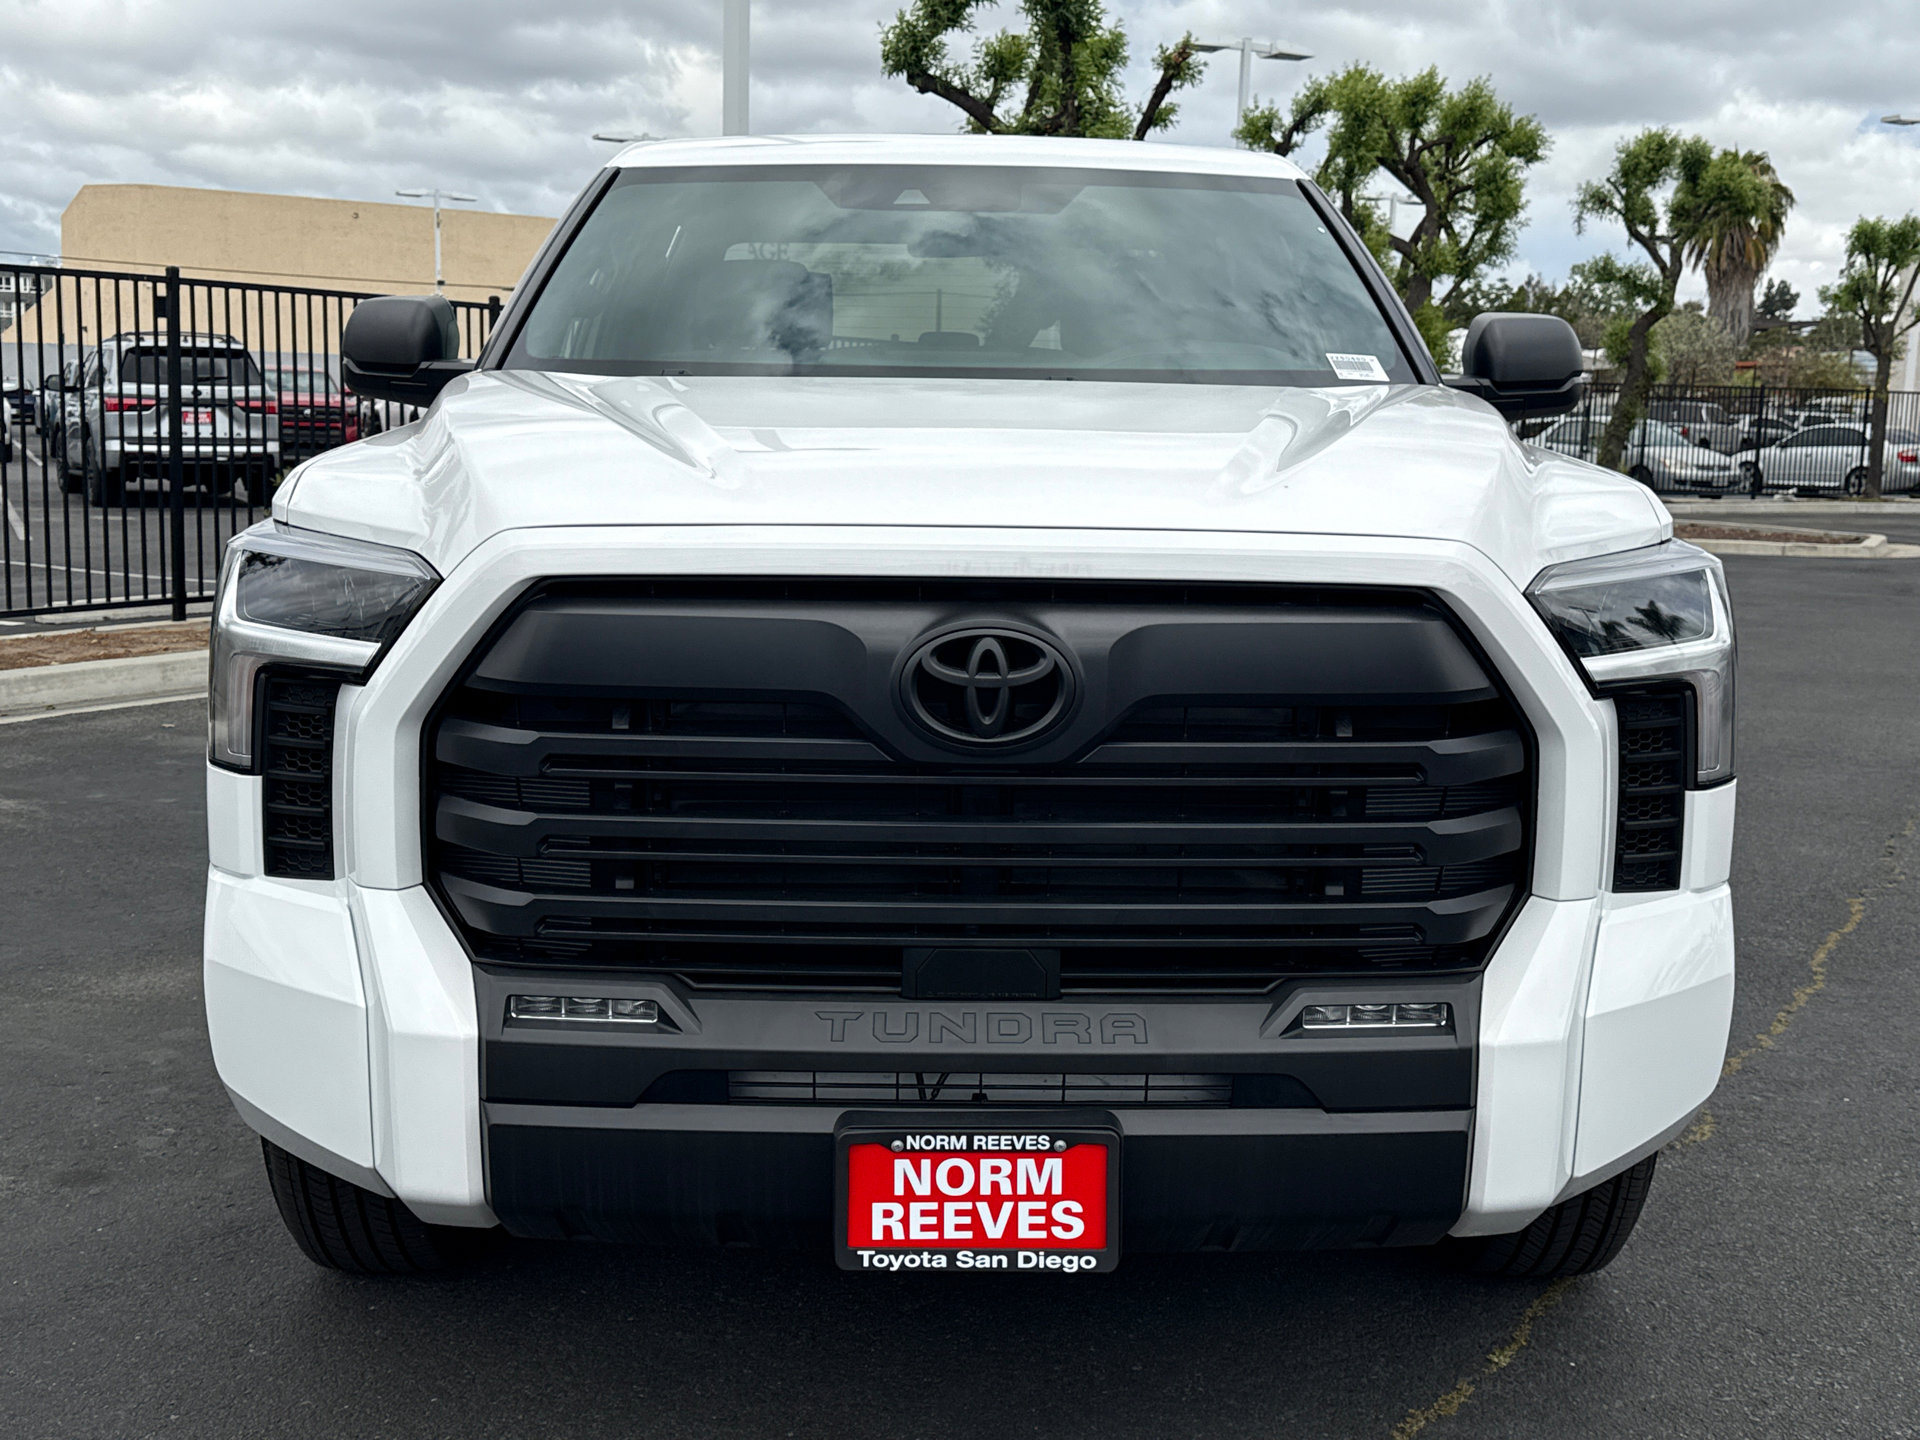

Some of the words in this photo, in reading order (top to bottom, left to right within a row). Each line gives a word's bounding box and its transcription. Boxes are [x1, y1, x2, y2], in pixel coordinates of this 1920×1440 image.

[814, 1010, 1148, 1044] TUNDRA
[906, 1135, 967, 1150] NORM
[973, 1135, 1050, 1150] REEVES
[893, 1158, 1063, 1196] NORM
[871, 1200, 1085, 1240] REEVES
[857, 1250, 947, 1271] Toyota
[956, 1251, 1008, 1269] San
[1017, 1251, 1097, 1273] Diego
